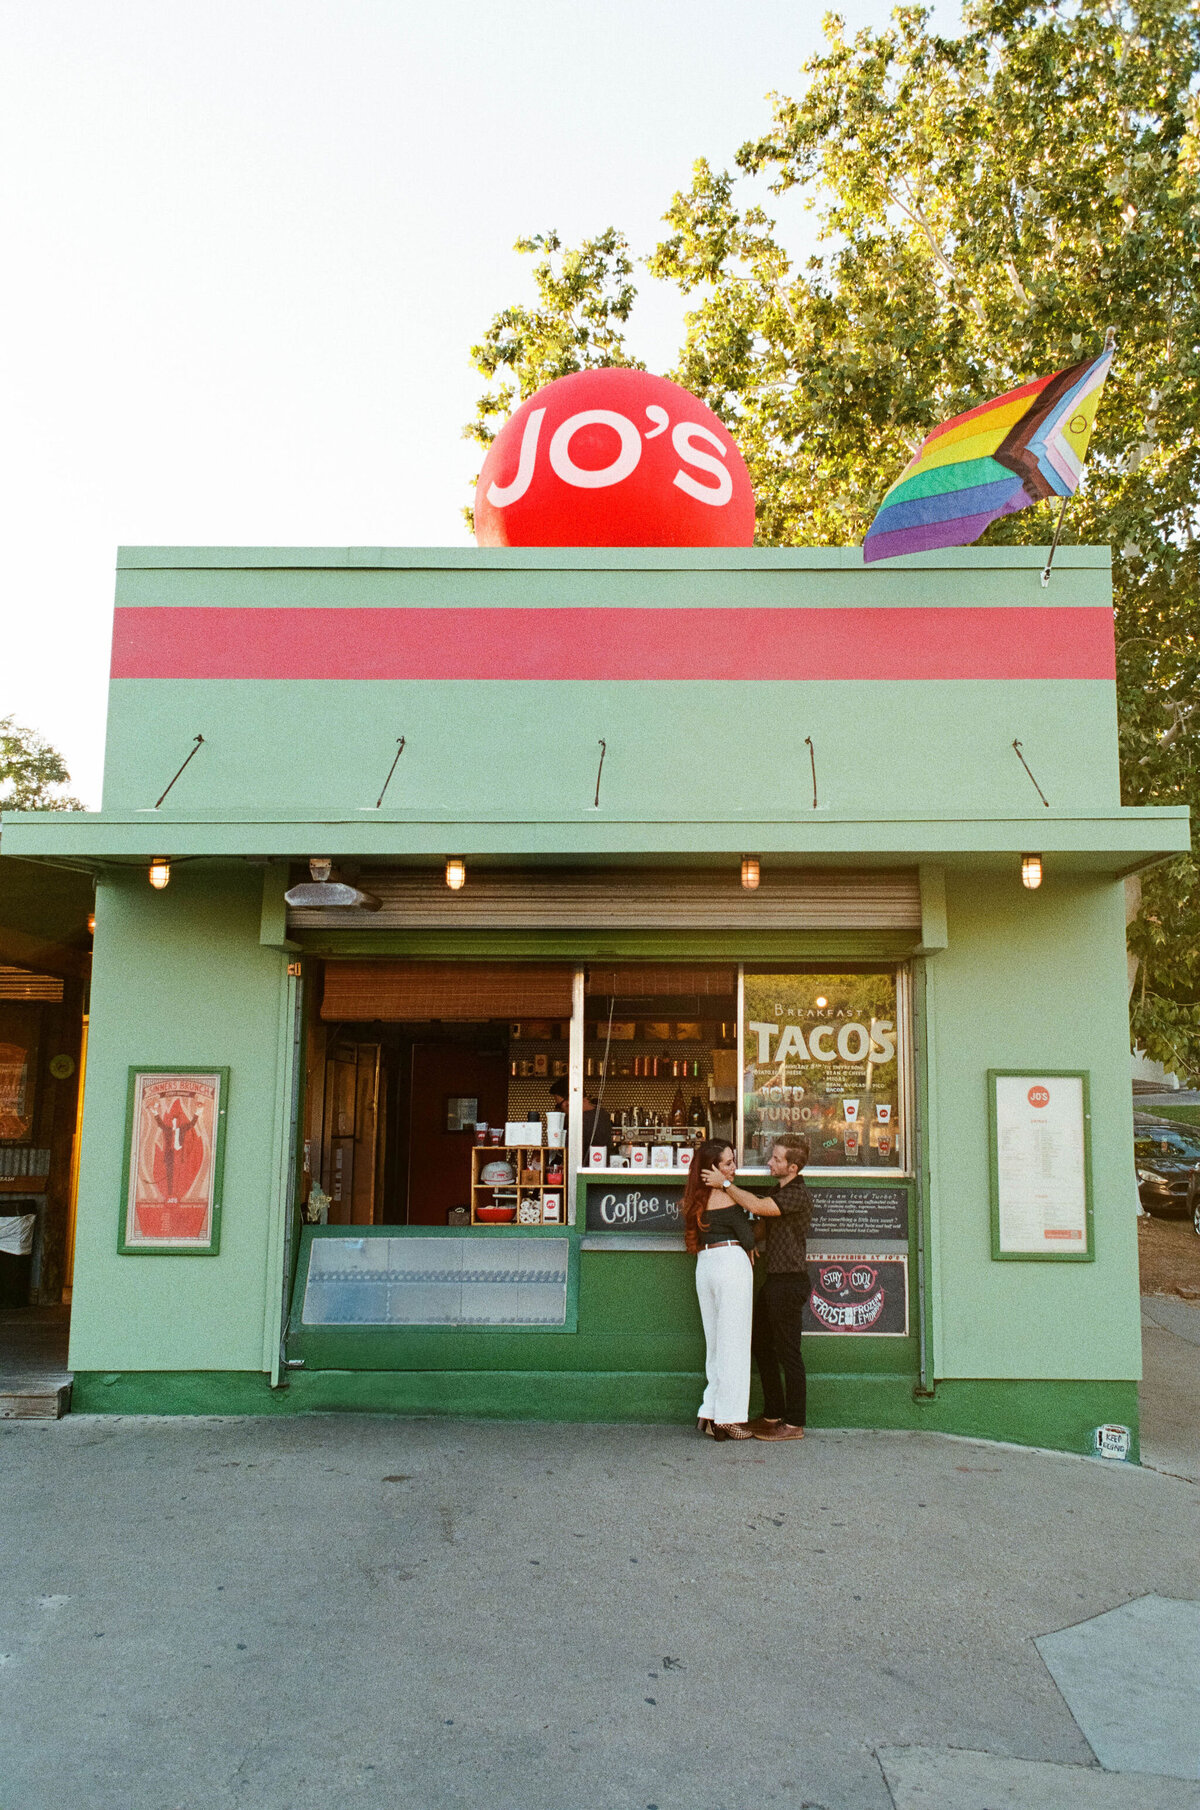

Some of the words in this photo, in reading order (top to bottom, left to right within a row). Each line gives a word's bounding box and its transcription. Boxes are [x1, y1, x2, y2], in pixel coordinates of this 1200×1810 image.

[486, 404, 733, 508] JO'S
[749, 1021, 894, 1064] TACOS
[149, 1080, 178, 1093] SINNERS
[179, 1079, 210, 1096] BRUNCH
[761, 1086, 805, 1102] ICED
[1030, 1092, 1048, 1101] JO'S
[756, 1106, 813, 1122] TURBO
[822, 1138, 838, 1149] COLD
[600, 1191, 660, 1224] Coffee
[665, 1199, 680, 1221] by
[823, 1272, 843, 1289] STAY
[851, 1272, 871, 1289] COOL
[853, 1297, 879, 1314] FROZEN
